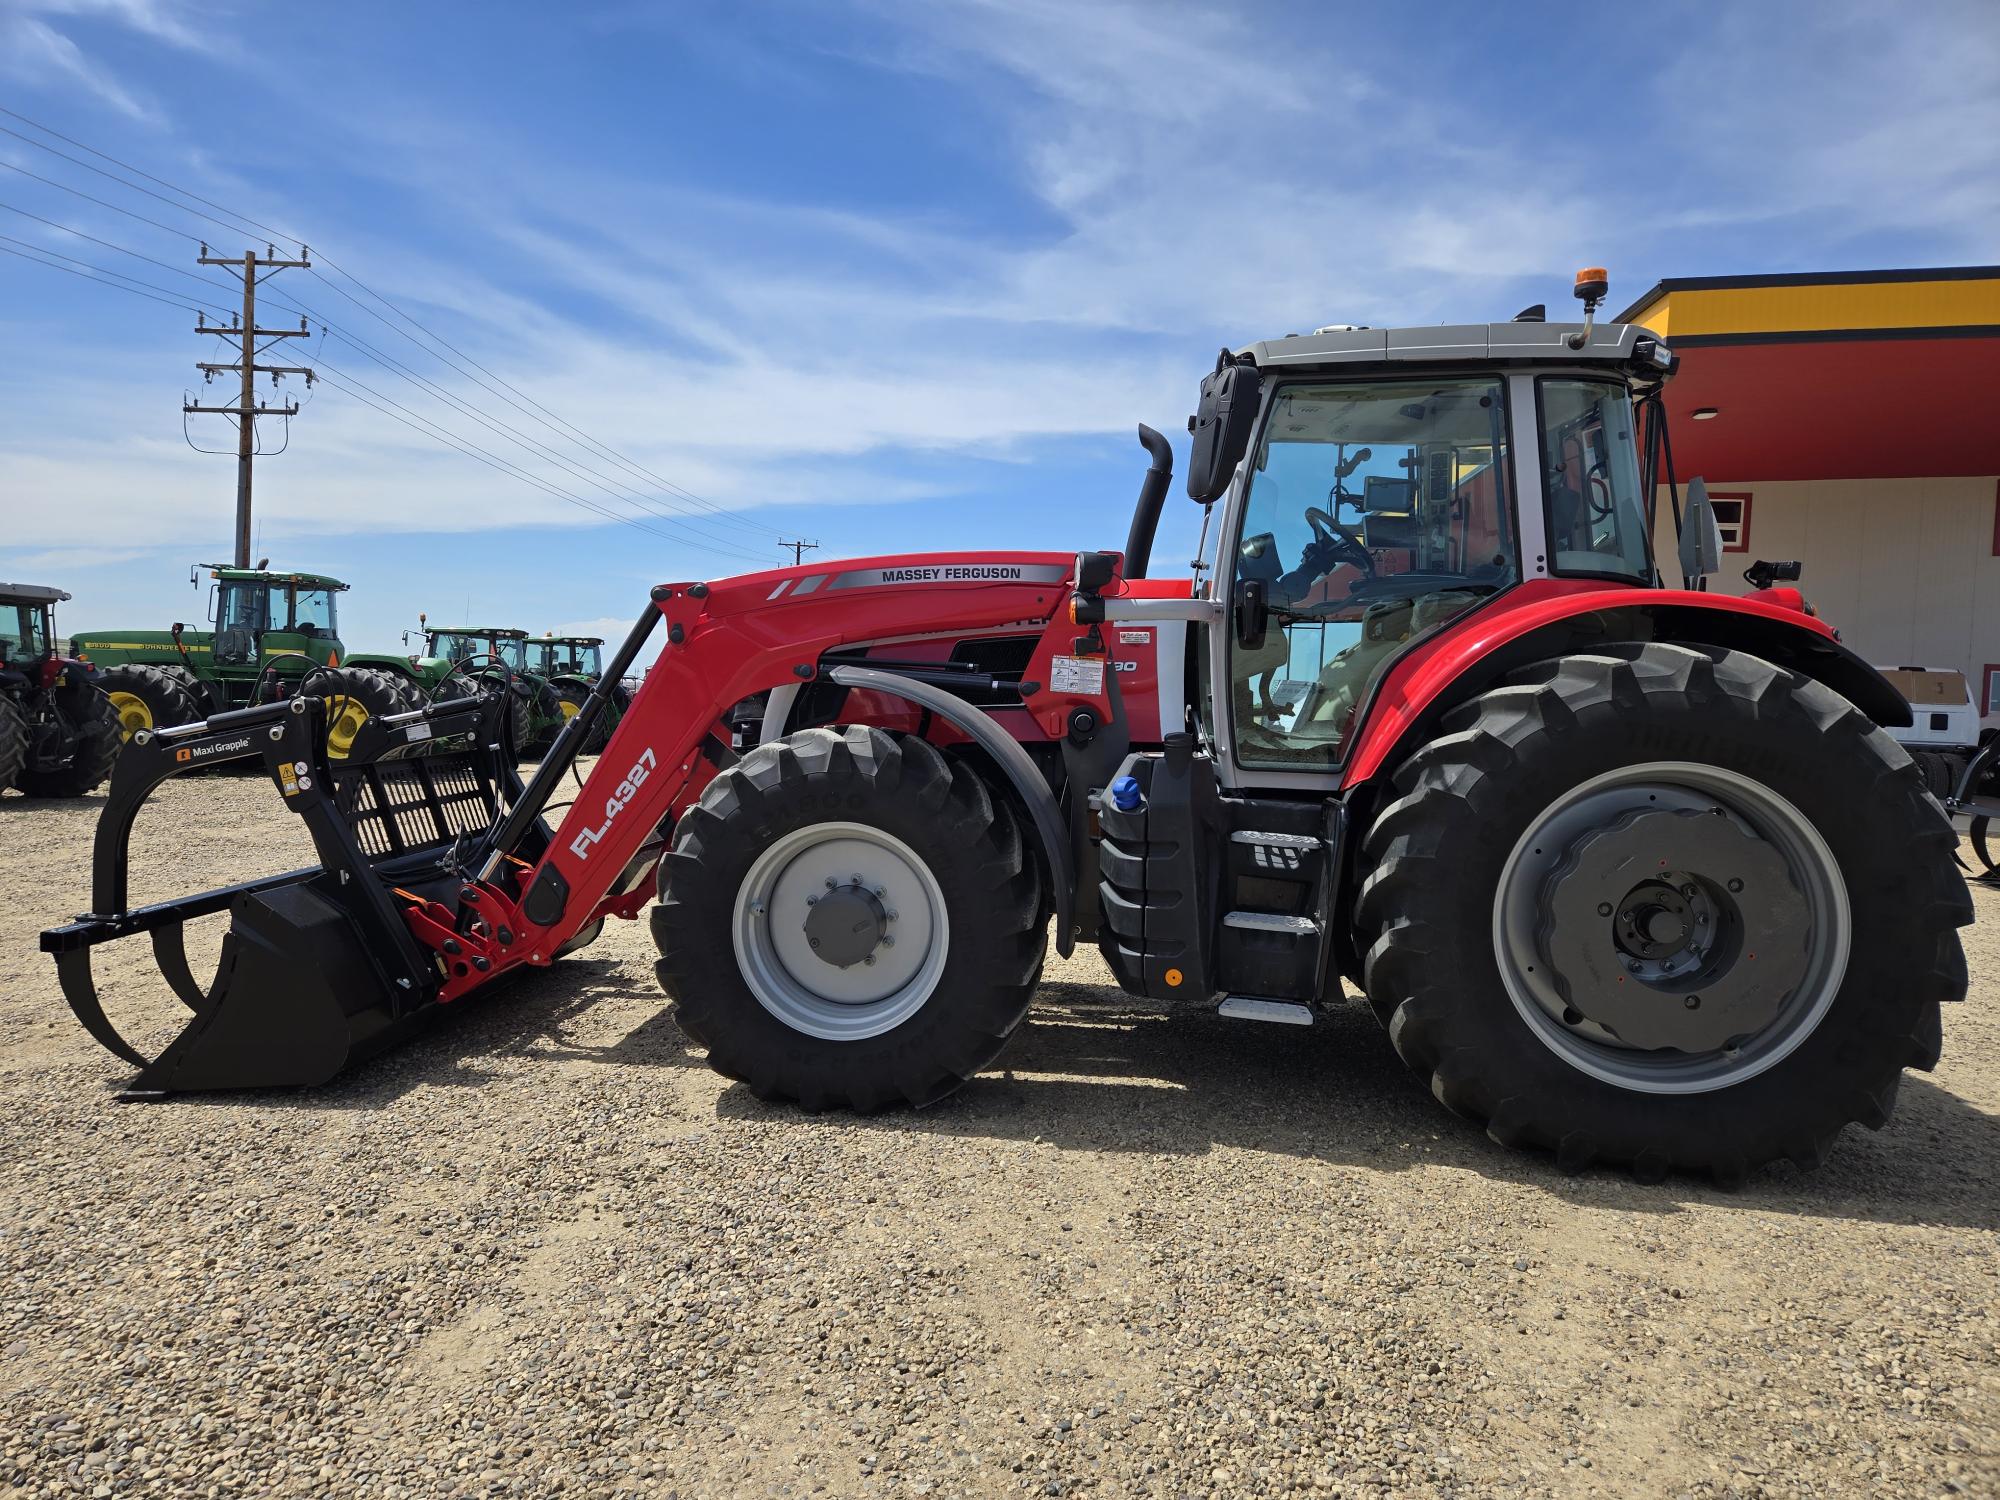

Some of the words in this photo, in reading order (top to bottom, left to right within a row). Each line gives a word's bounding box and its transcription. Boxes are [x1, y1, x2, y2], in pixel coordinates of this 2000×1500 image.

[882, 568, 941, 582] MASSEY
[945, 567, 1021, 579] FERGUSON
[163, 644, 190, 652] DEEE
[192, 745, 215, 757] Maxi
[215, 739, 249, 752] Grapple
[569, 747, 657, 861] FL.4327
